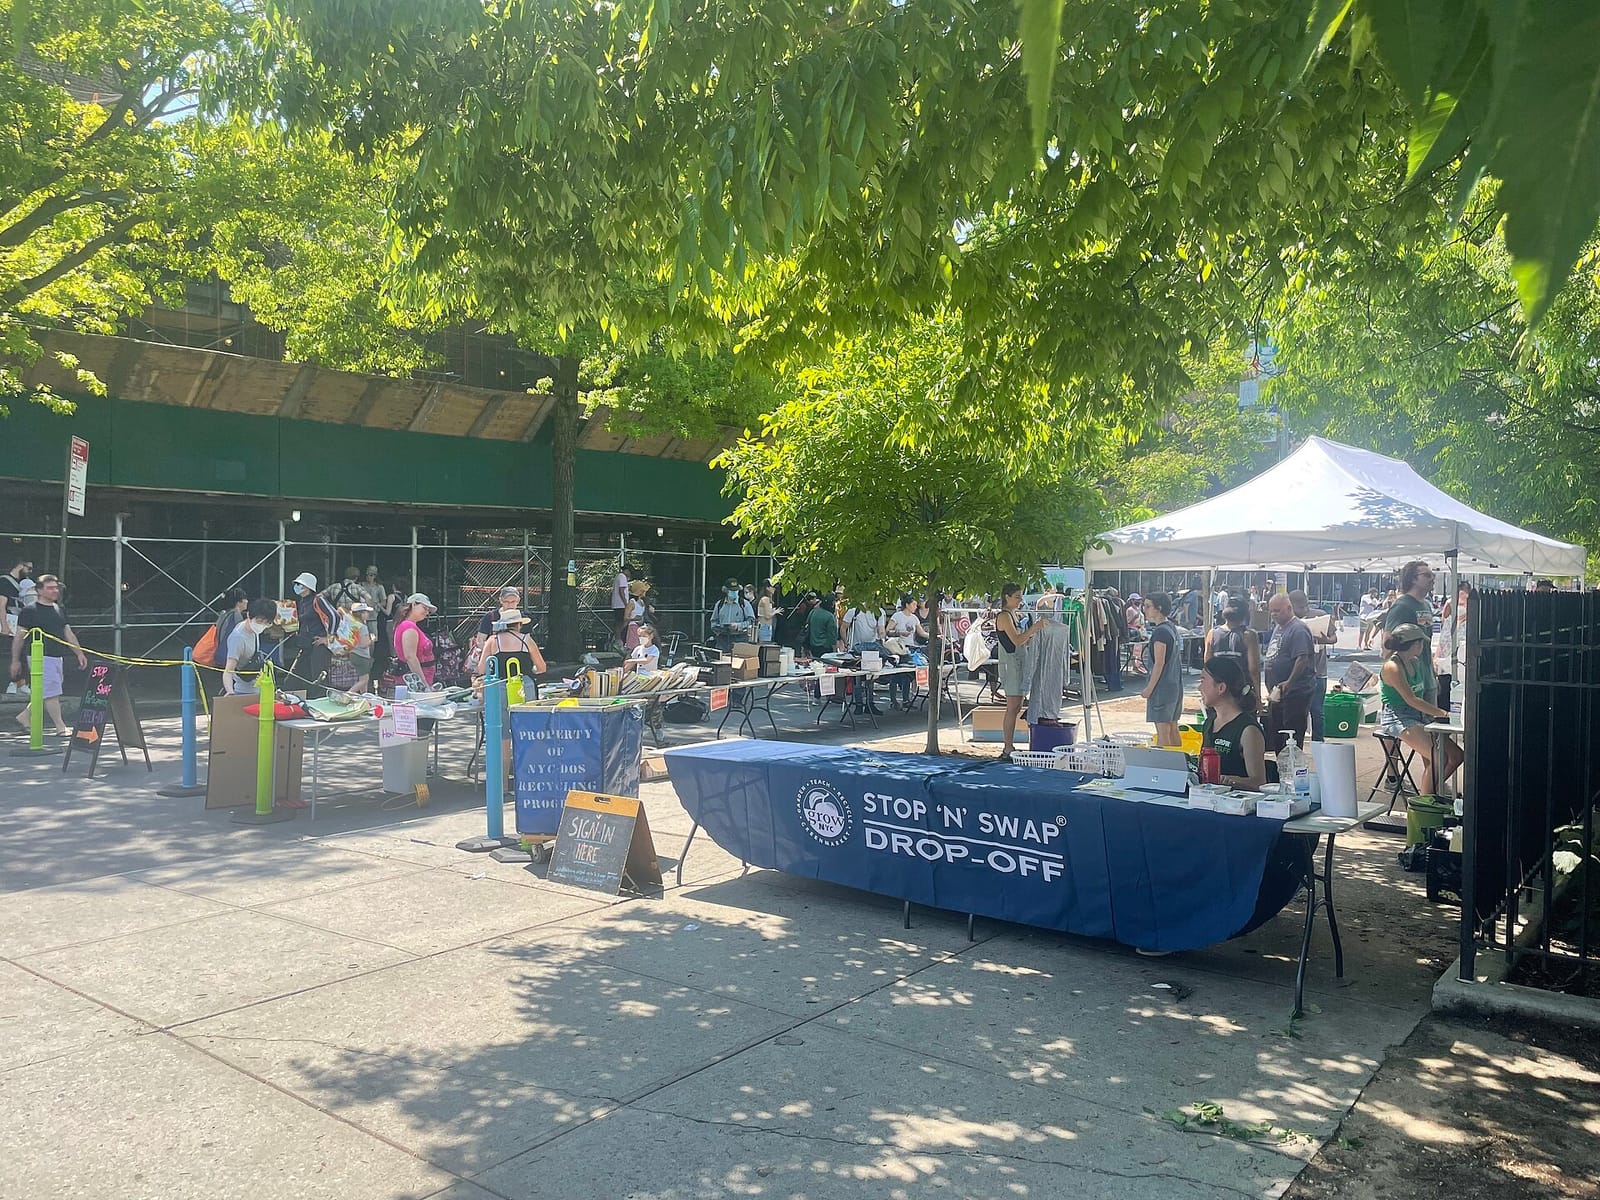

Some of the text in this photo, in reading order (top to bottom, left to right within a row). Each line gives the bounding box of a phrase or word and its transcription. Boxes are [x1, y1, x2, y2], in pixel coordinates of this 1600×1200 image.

[519, 728, 592, 741] PROPERTY
[547, 747, 564, 757] OF
[527, 764, 586, 774] NYC DOS
[518, 781, 597, 792] RECYCLING
[810, 779, 831, 788] TEACH
[796, 785, 806, 813] GARDEN
[836, 791, 853, 824] RECYCLE
[863, 791, 927, 821] STOP
[807, 810, 845, 827] grow
[818, 823, 835, 833] NYC
[568, 815, 616, 844] SIGN-IN
[800, 821, 850, 847] GREENMARKET
[575, 842, 601, 864] HERE
[865, 827, 1065, 883] DROP-OFF
